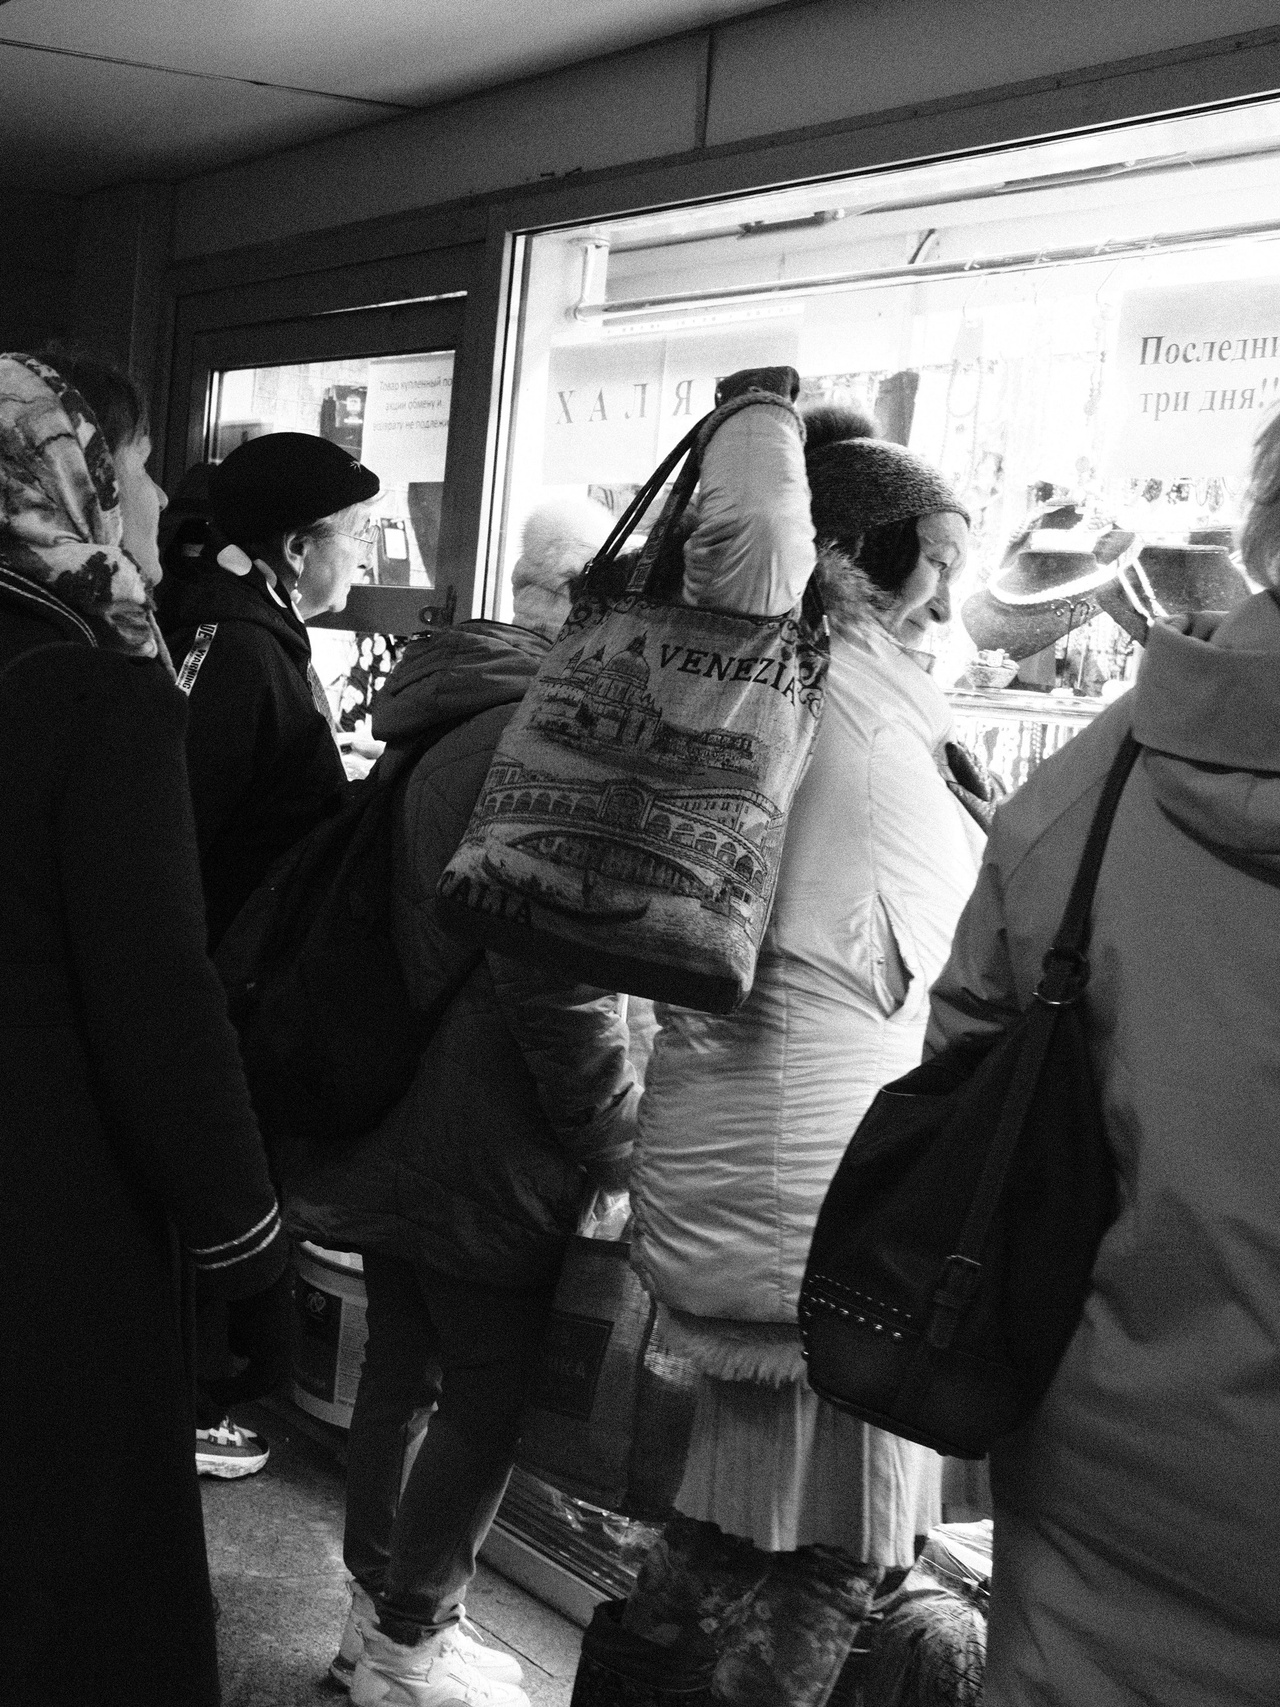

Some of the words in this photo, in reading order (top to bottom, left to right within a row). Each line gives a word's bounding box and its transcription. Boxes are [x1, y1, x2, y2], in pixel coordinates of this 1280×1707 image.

[556, 376, 724, 425] ХАЛЯ
[1139, 391, 1191, 421] три
[182, 648, 207, 690] WARNING
[661, 643, 796, 707] VENEZIA
[439, 870, 529, 923] TALIA
